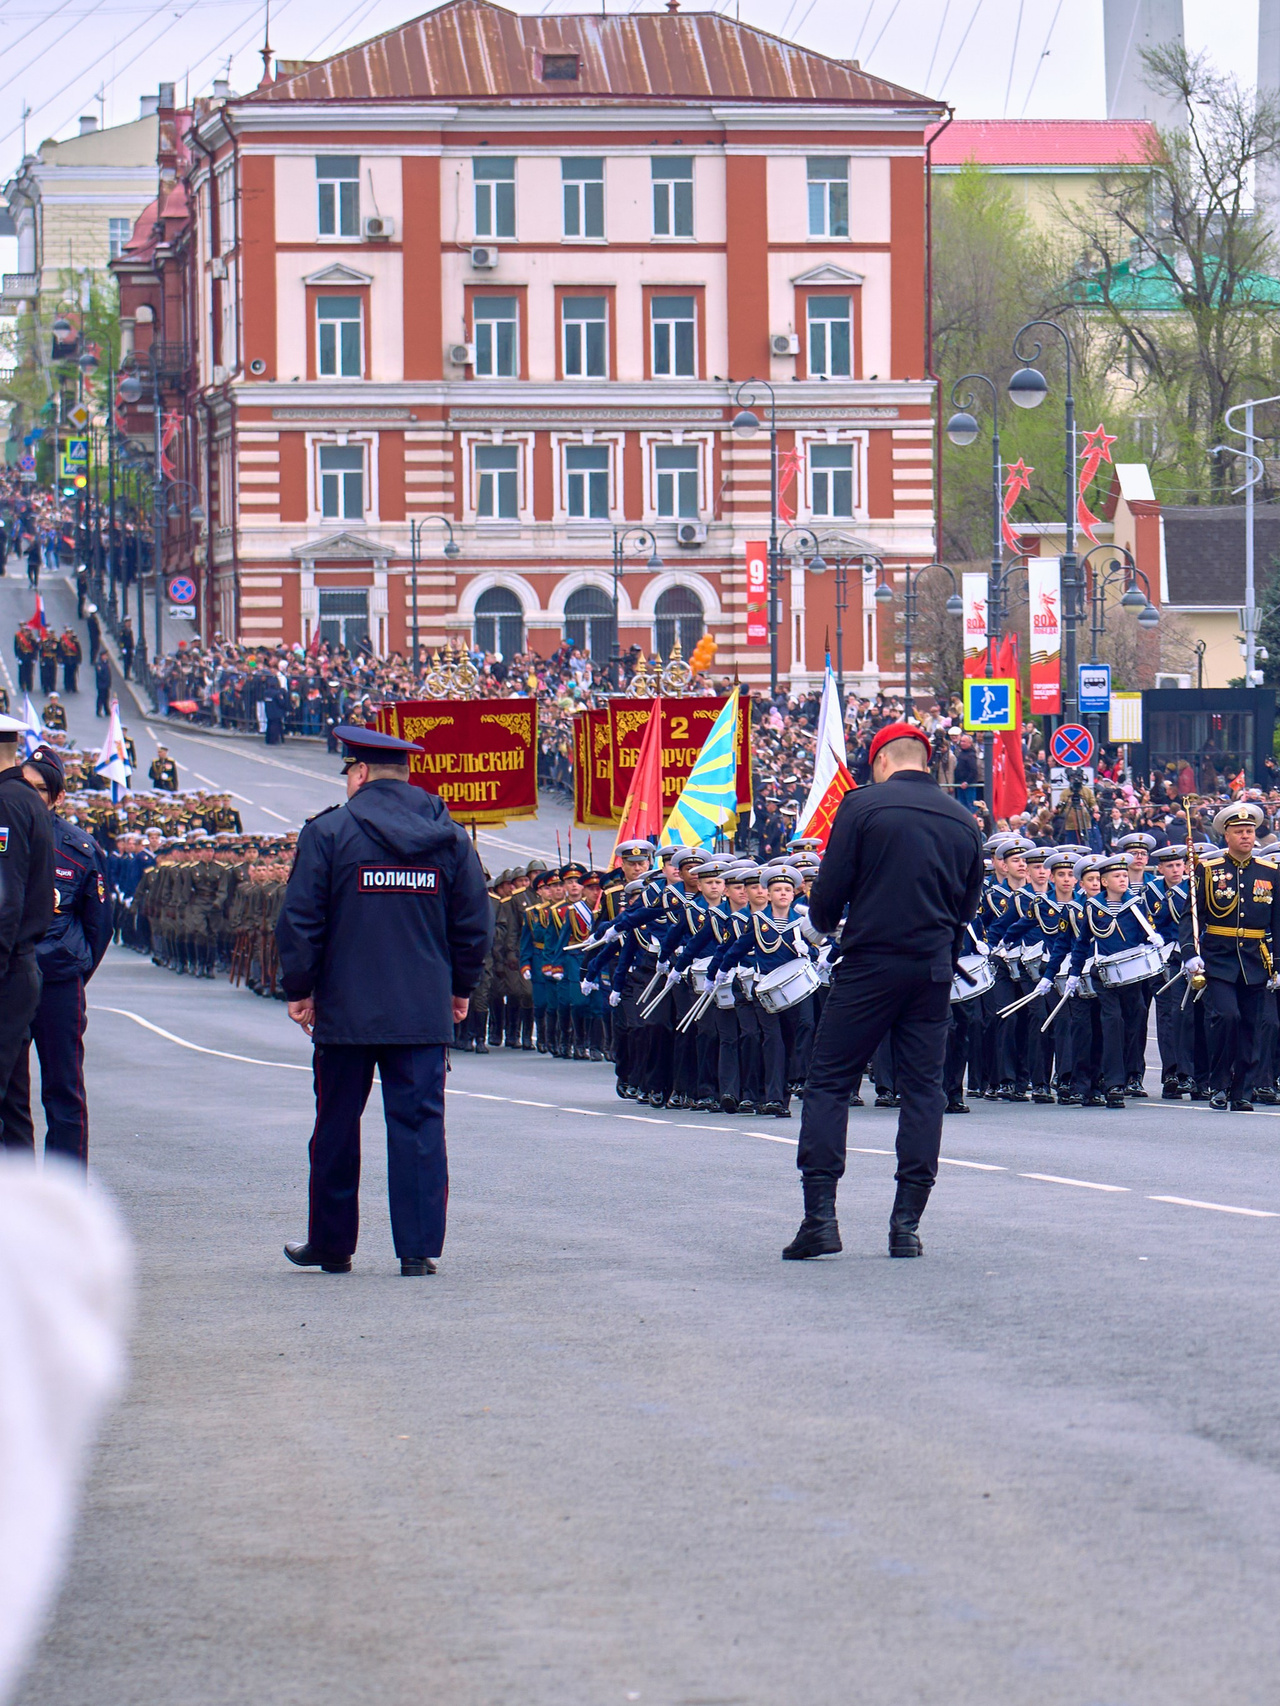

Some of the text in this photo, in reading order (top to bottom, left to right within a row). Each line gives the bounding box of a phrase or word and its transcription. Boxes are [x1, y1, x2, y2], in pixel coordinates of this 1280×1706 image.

[750, 559, 764, 584] 9
[670, 716, 690, 739] 2
[409, 746, 525, 774] КАРЕЛЬСКИЙ
[437, 780, 501, 802] ФРОНТ
[363, 871, 436, 889] ПОЛИЦИЯ
